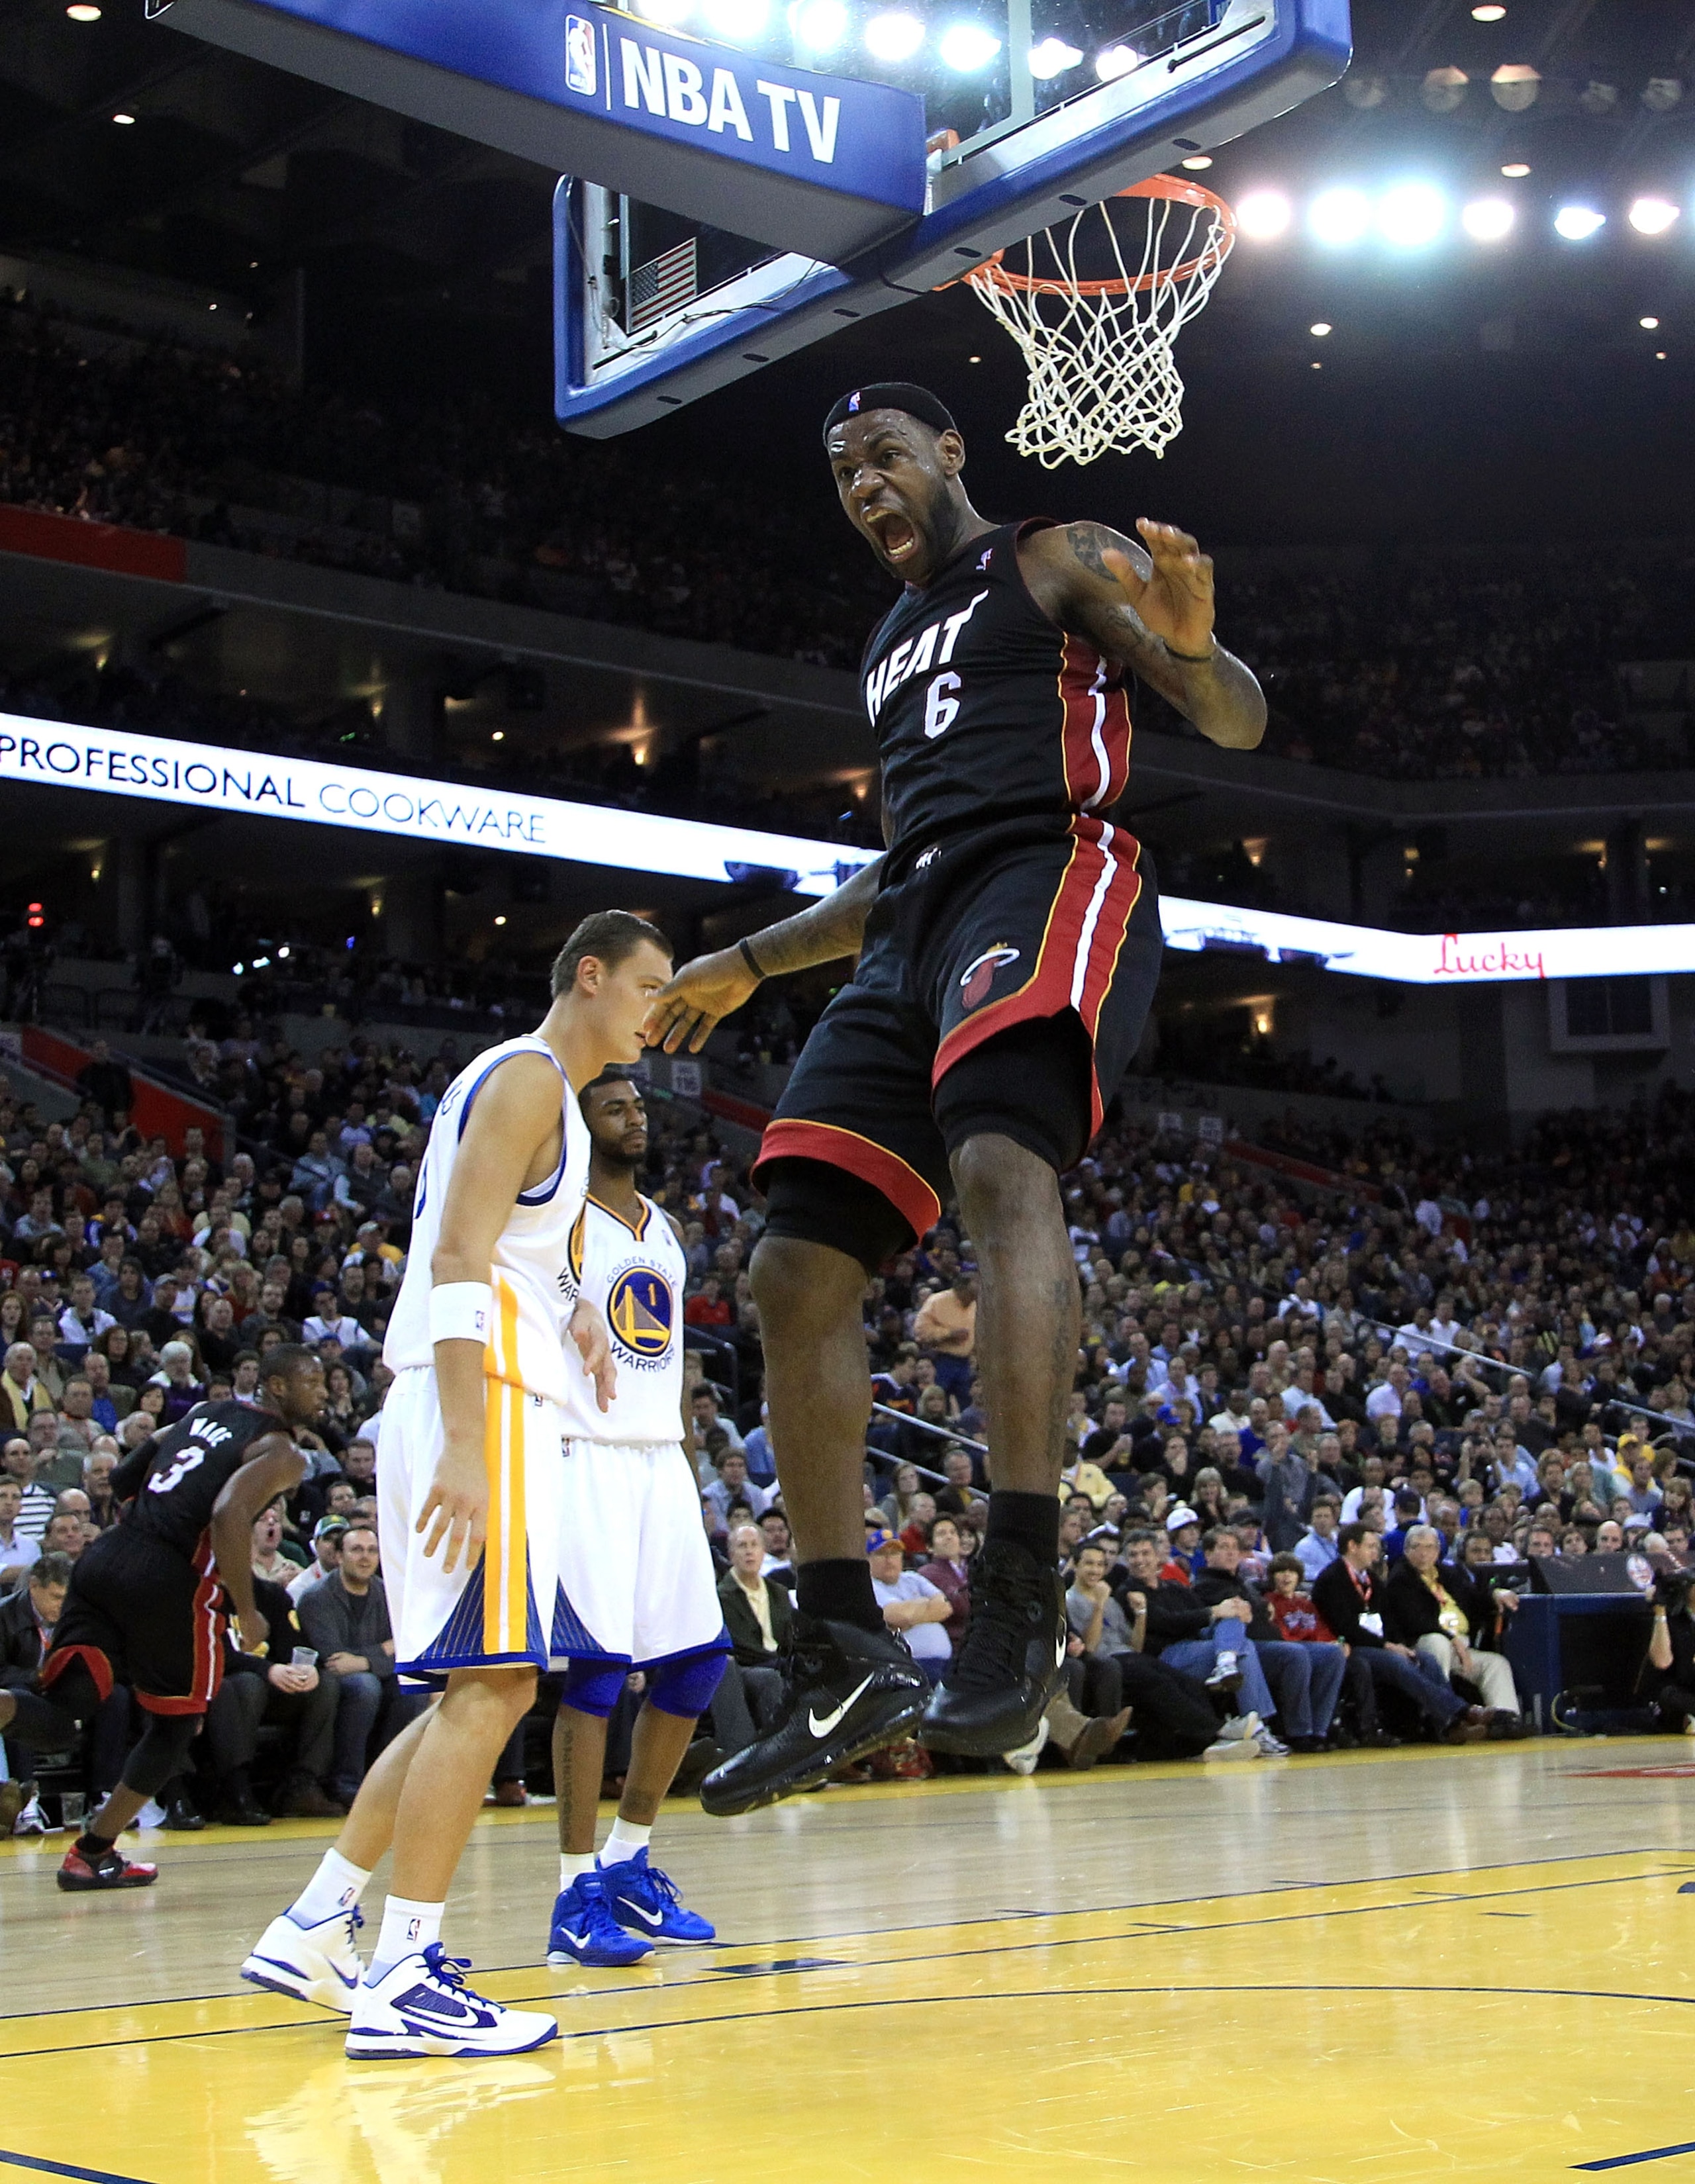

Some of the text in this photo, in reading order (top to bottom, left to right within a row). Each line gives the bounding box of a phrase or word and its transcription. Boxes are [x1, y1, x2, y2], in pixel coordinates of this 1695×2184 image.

[620, 37, 841, 164] NBA TV
[866, 589, 989, 727] HEAT
[924, 671, 961, 739] 6
[0, 734, 546, 844] PROFESSIONAL COOKWARE
[1433, 933, 1546, 978] Lucky
[607, 1256, 645, 1284] GOLDEN
[648, 1282, 657, 1306] 1
[148, 1446, 205, 1494] 3
